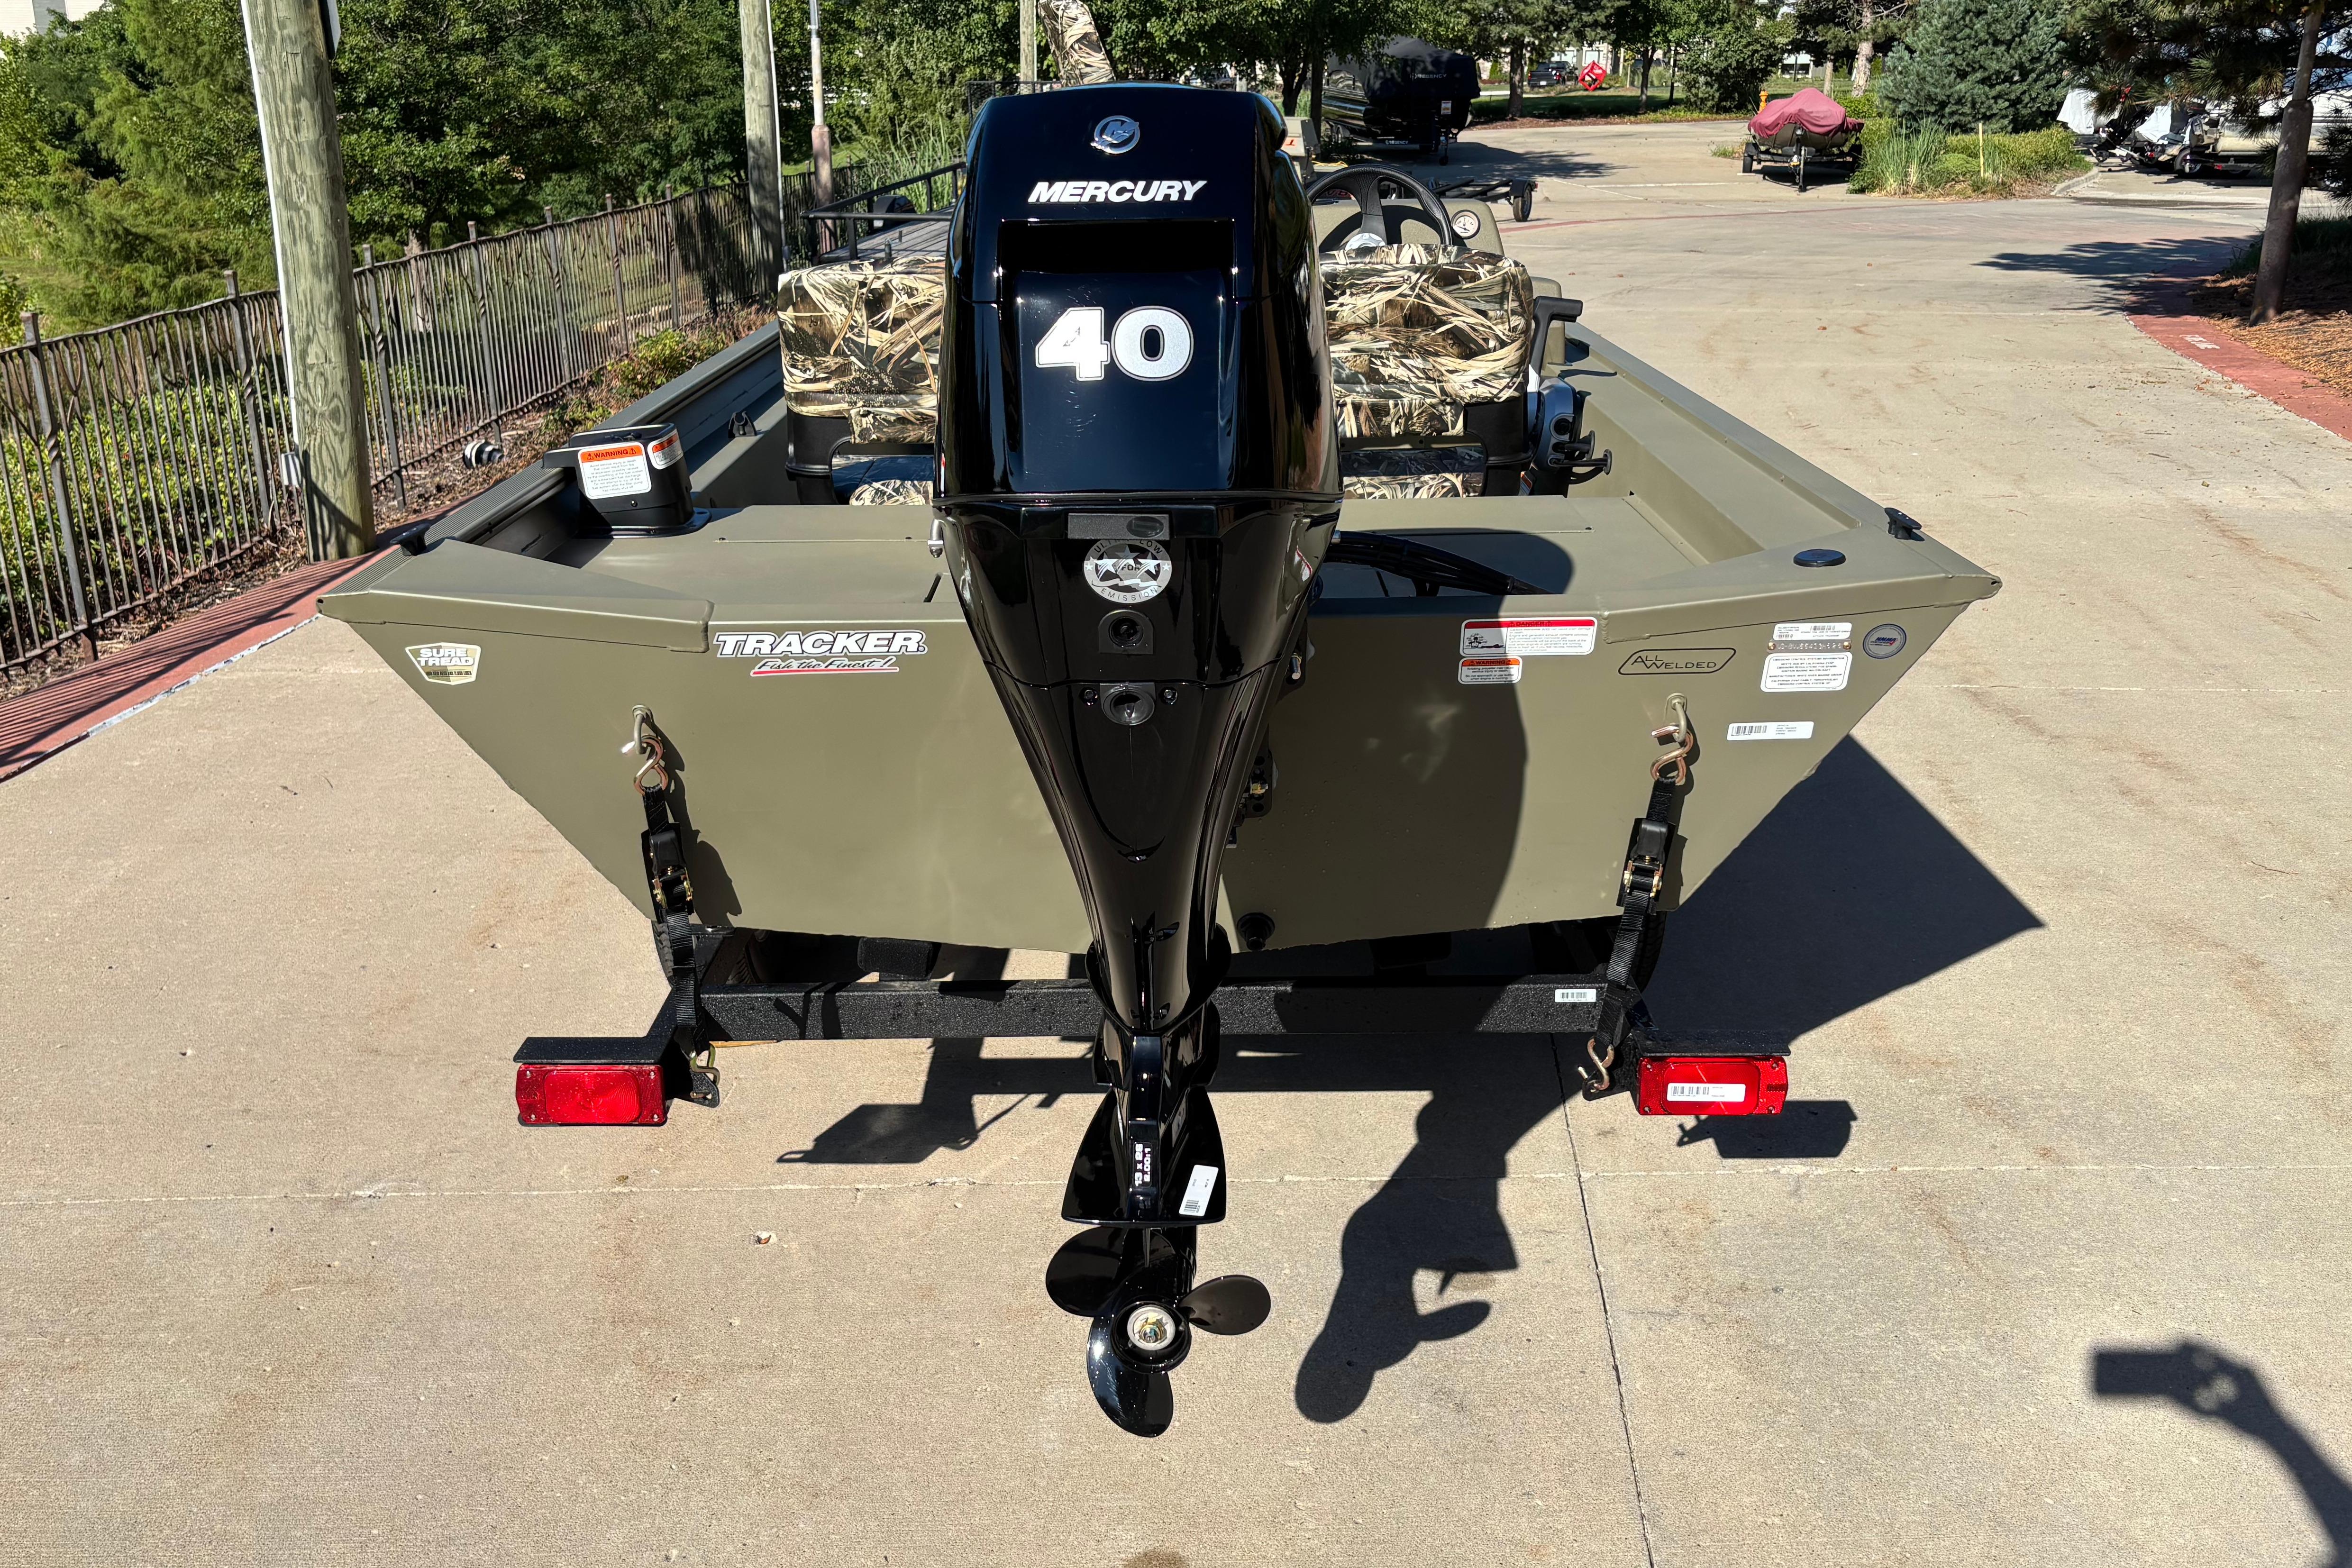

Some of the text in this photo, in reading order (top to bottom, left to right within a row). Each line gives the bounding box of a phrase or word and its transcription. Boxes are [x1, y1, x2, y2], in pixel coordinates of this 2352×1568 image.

[1028, 180, 1207, 203] MERCURY
[1035, 305, 1194, 381] 40
[594, 449, 629, 458] WARNING
[1139, 539, 1163, 554] LOW
[1100, 587, 1158, 602] EMISSION
[716, 631, 925, 656] TRACKER
[419, 648, 467, 658] SURE
[417, 656, 474, 666] TREAD
[757, 659, 793, 669] Fish
[796, 659, 821, 669] the
[1631, 655, 1664, 665] ALL
[1645, 661, 1717, 669] WELDED
